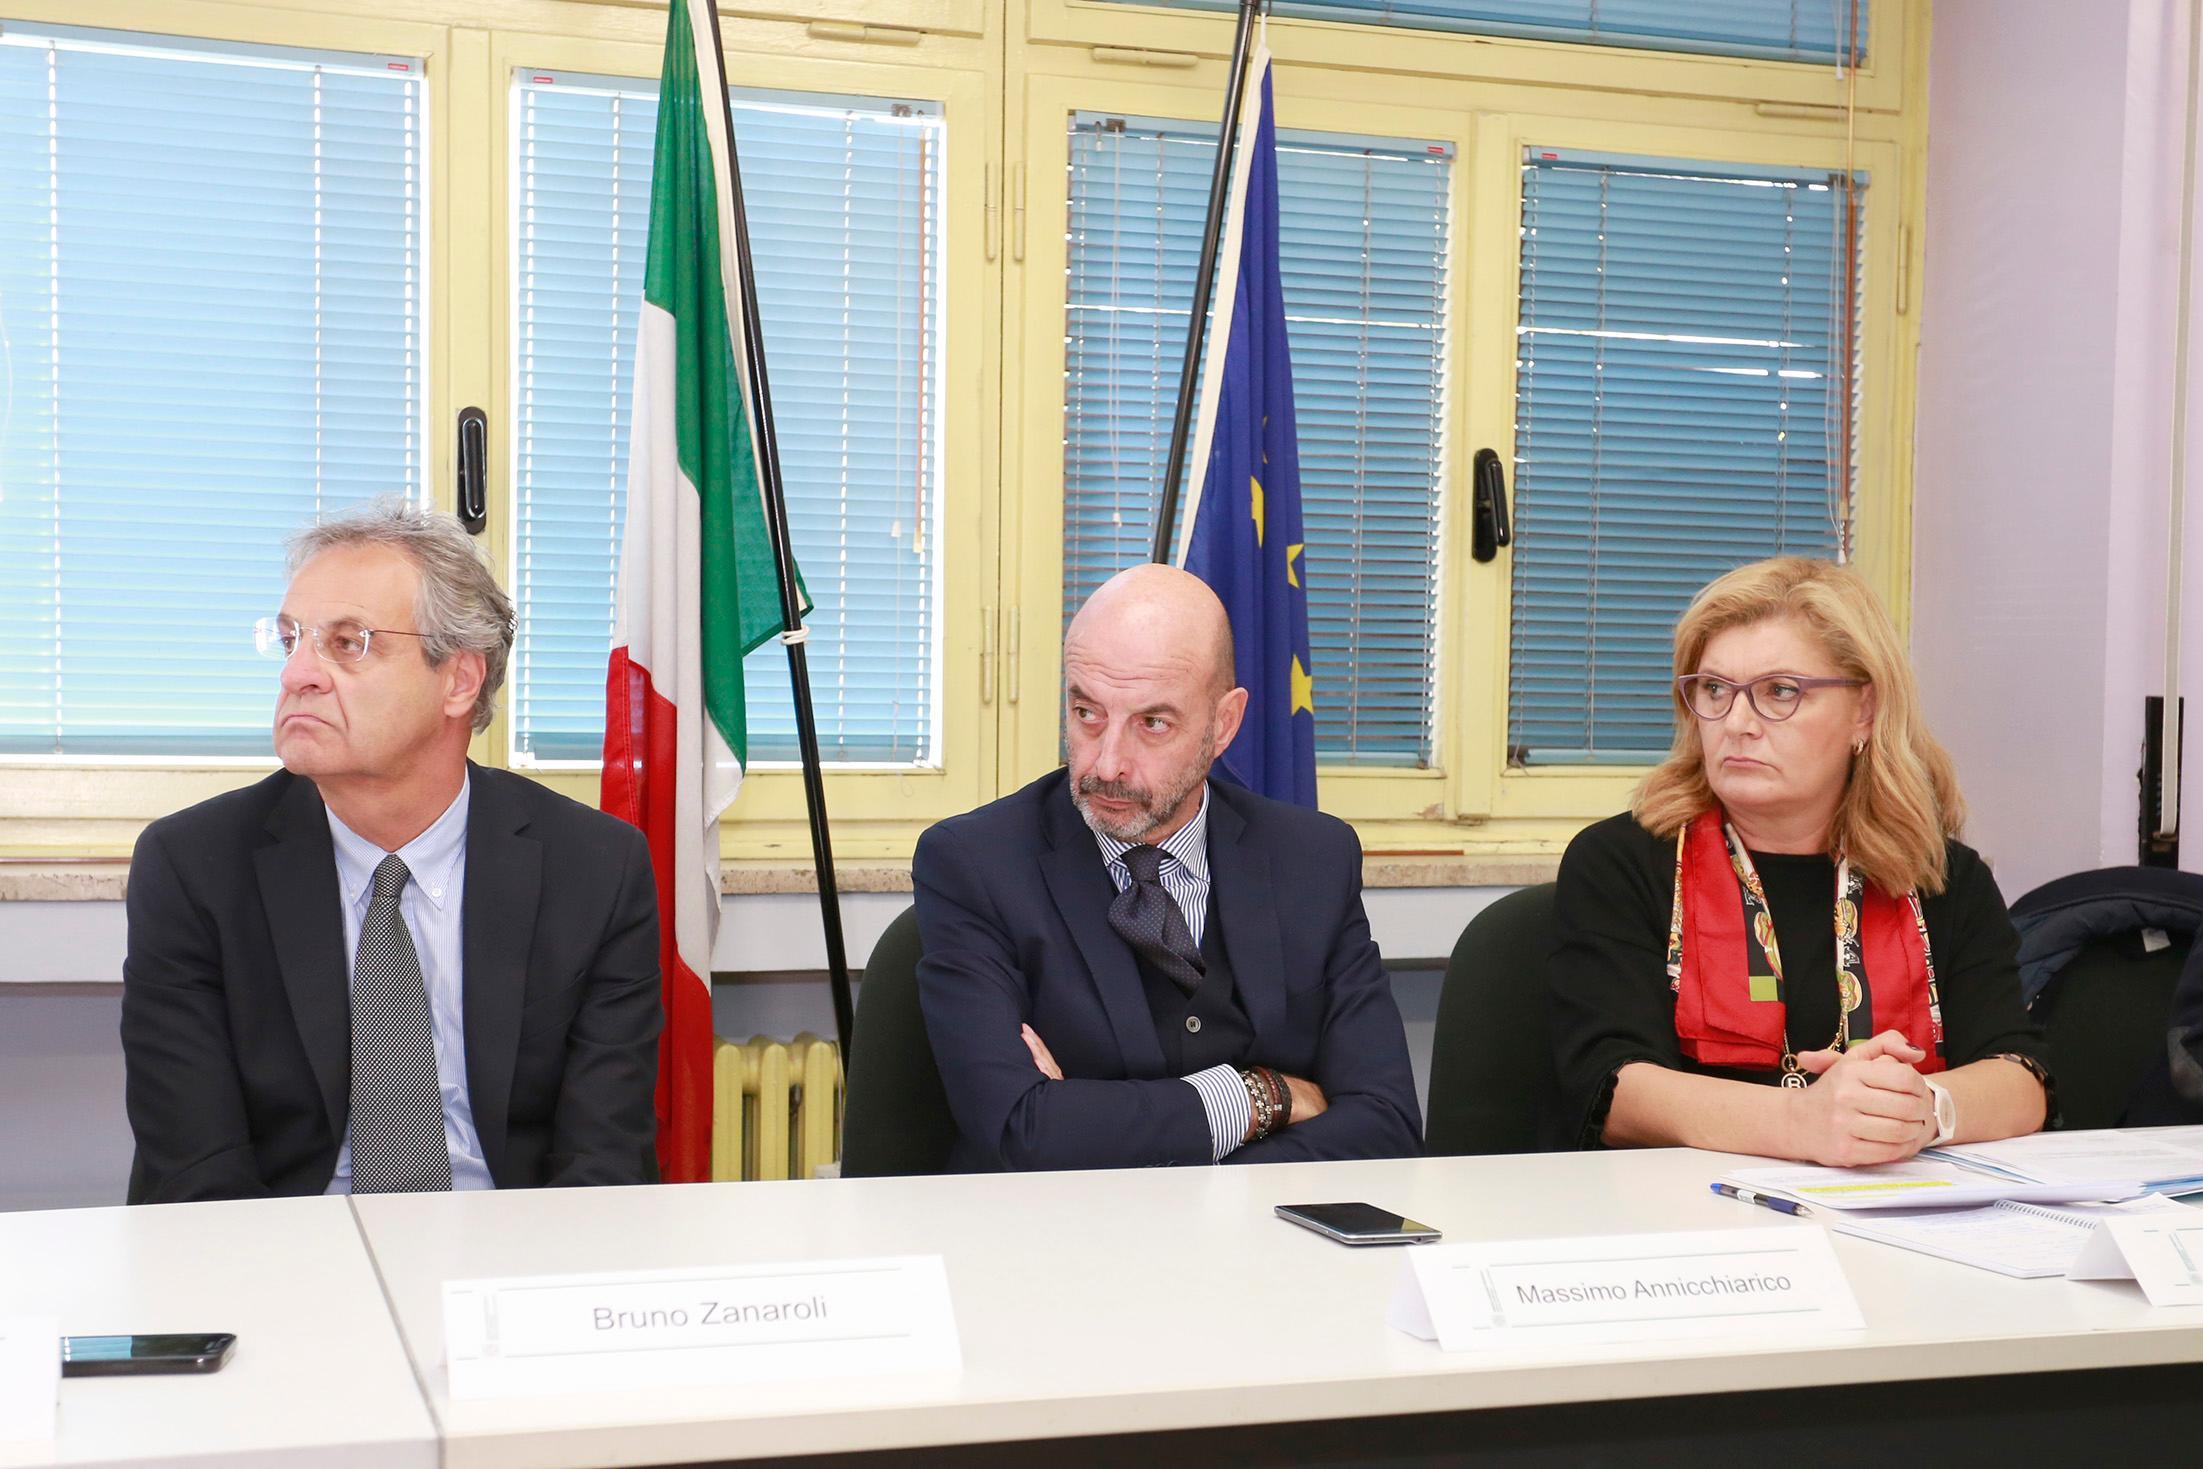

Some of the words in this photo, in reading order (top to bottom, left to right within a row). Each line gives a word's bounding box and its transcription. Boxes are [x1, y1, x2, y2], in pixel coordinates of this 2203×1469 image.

[1515, 1283, 1628, 1305] Massimo
[1633, 1273, 1792, 1299] Annicchiarico
[593, 1307, 689, 1331] Bruno
[700, 1296, 828, 1325] Zanaroli
